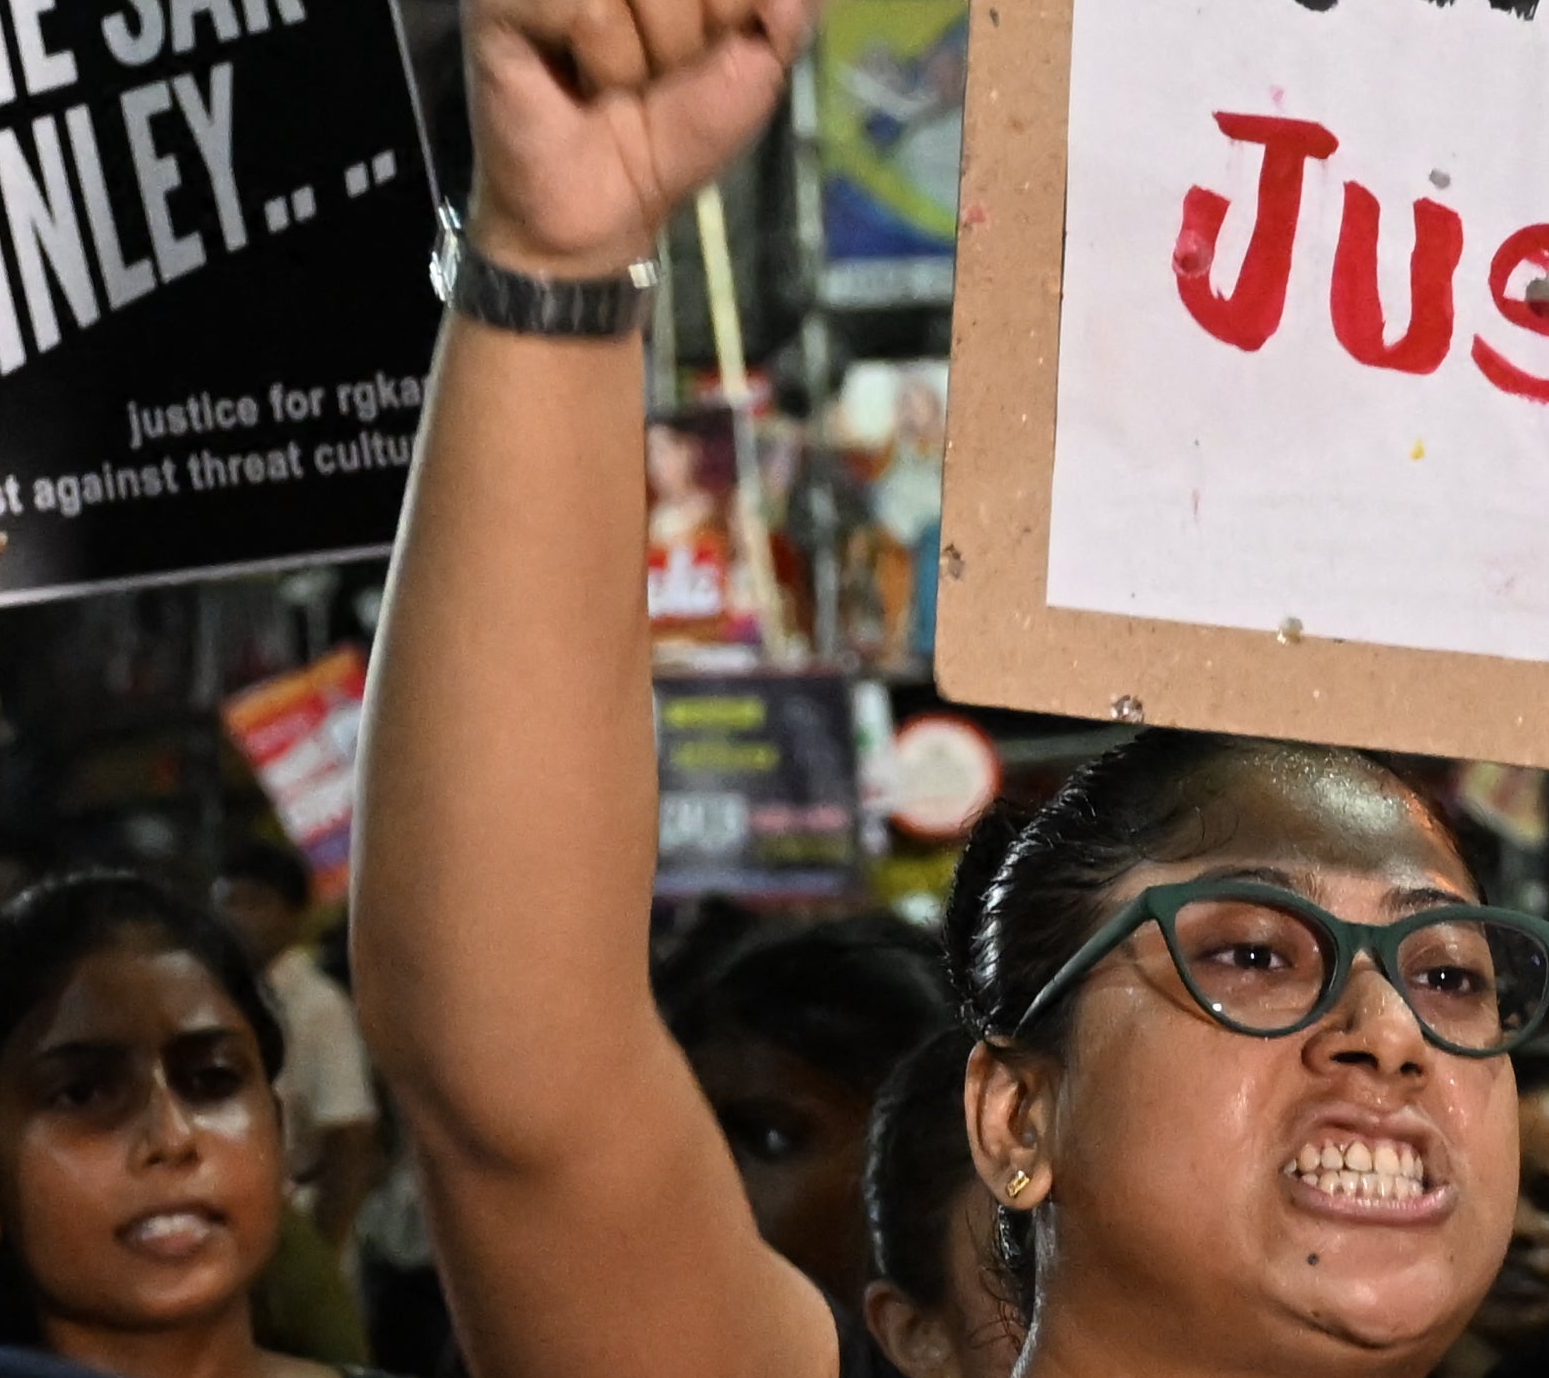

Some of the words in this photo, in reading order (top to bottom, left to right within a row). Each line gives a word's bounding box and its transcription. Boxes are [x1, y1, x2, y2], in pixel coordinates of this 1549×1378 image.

[126, 392, 259, 450] justice
[269, 382, 325, 422] for
[32, 455, 179, 518] against
[186, 439, 303, 490] threat
[313, 429, 417, 475] cultu
